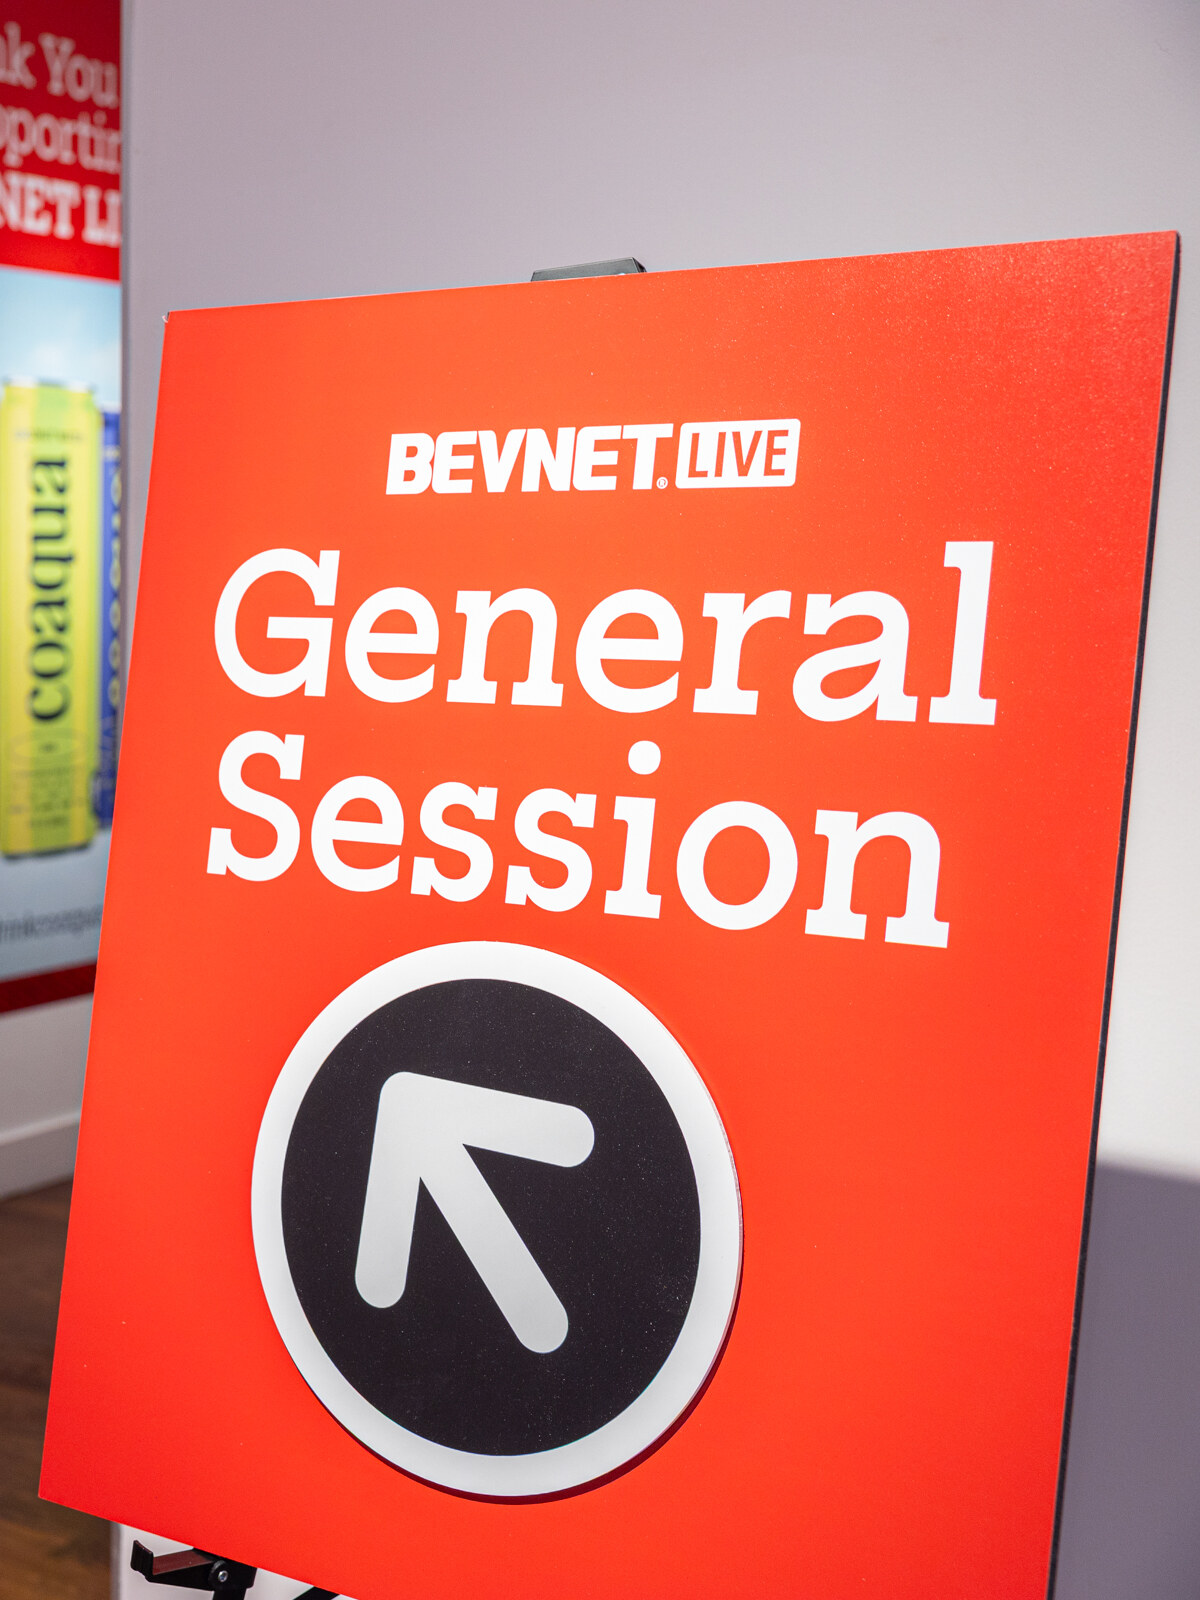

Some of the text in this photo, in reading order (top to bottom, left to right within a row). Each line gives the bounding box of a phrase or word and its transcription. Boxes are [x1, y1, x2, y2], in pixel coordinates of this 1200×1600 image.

[38, 32, 118, 109] You
[687, 429, 790, 479] LIVE
[29, 459, 74, 723] coaqua
[214, 540, 998, 726] General
[205, 729, 951, 950] Session
